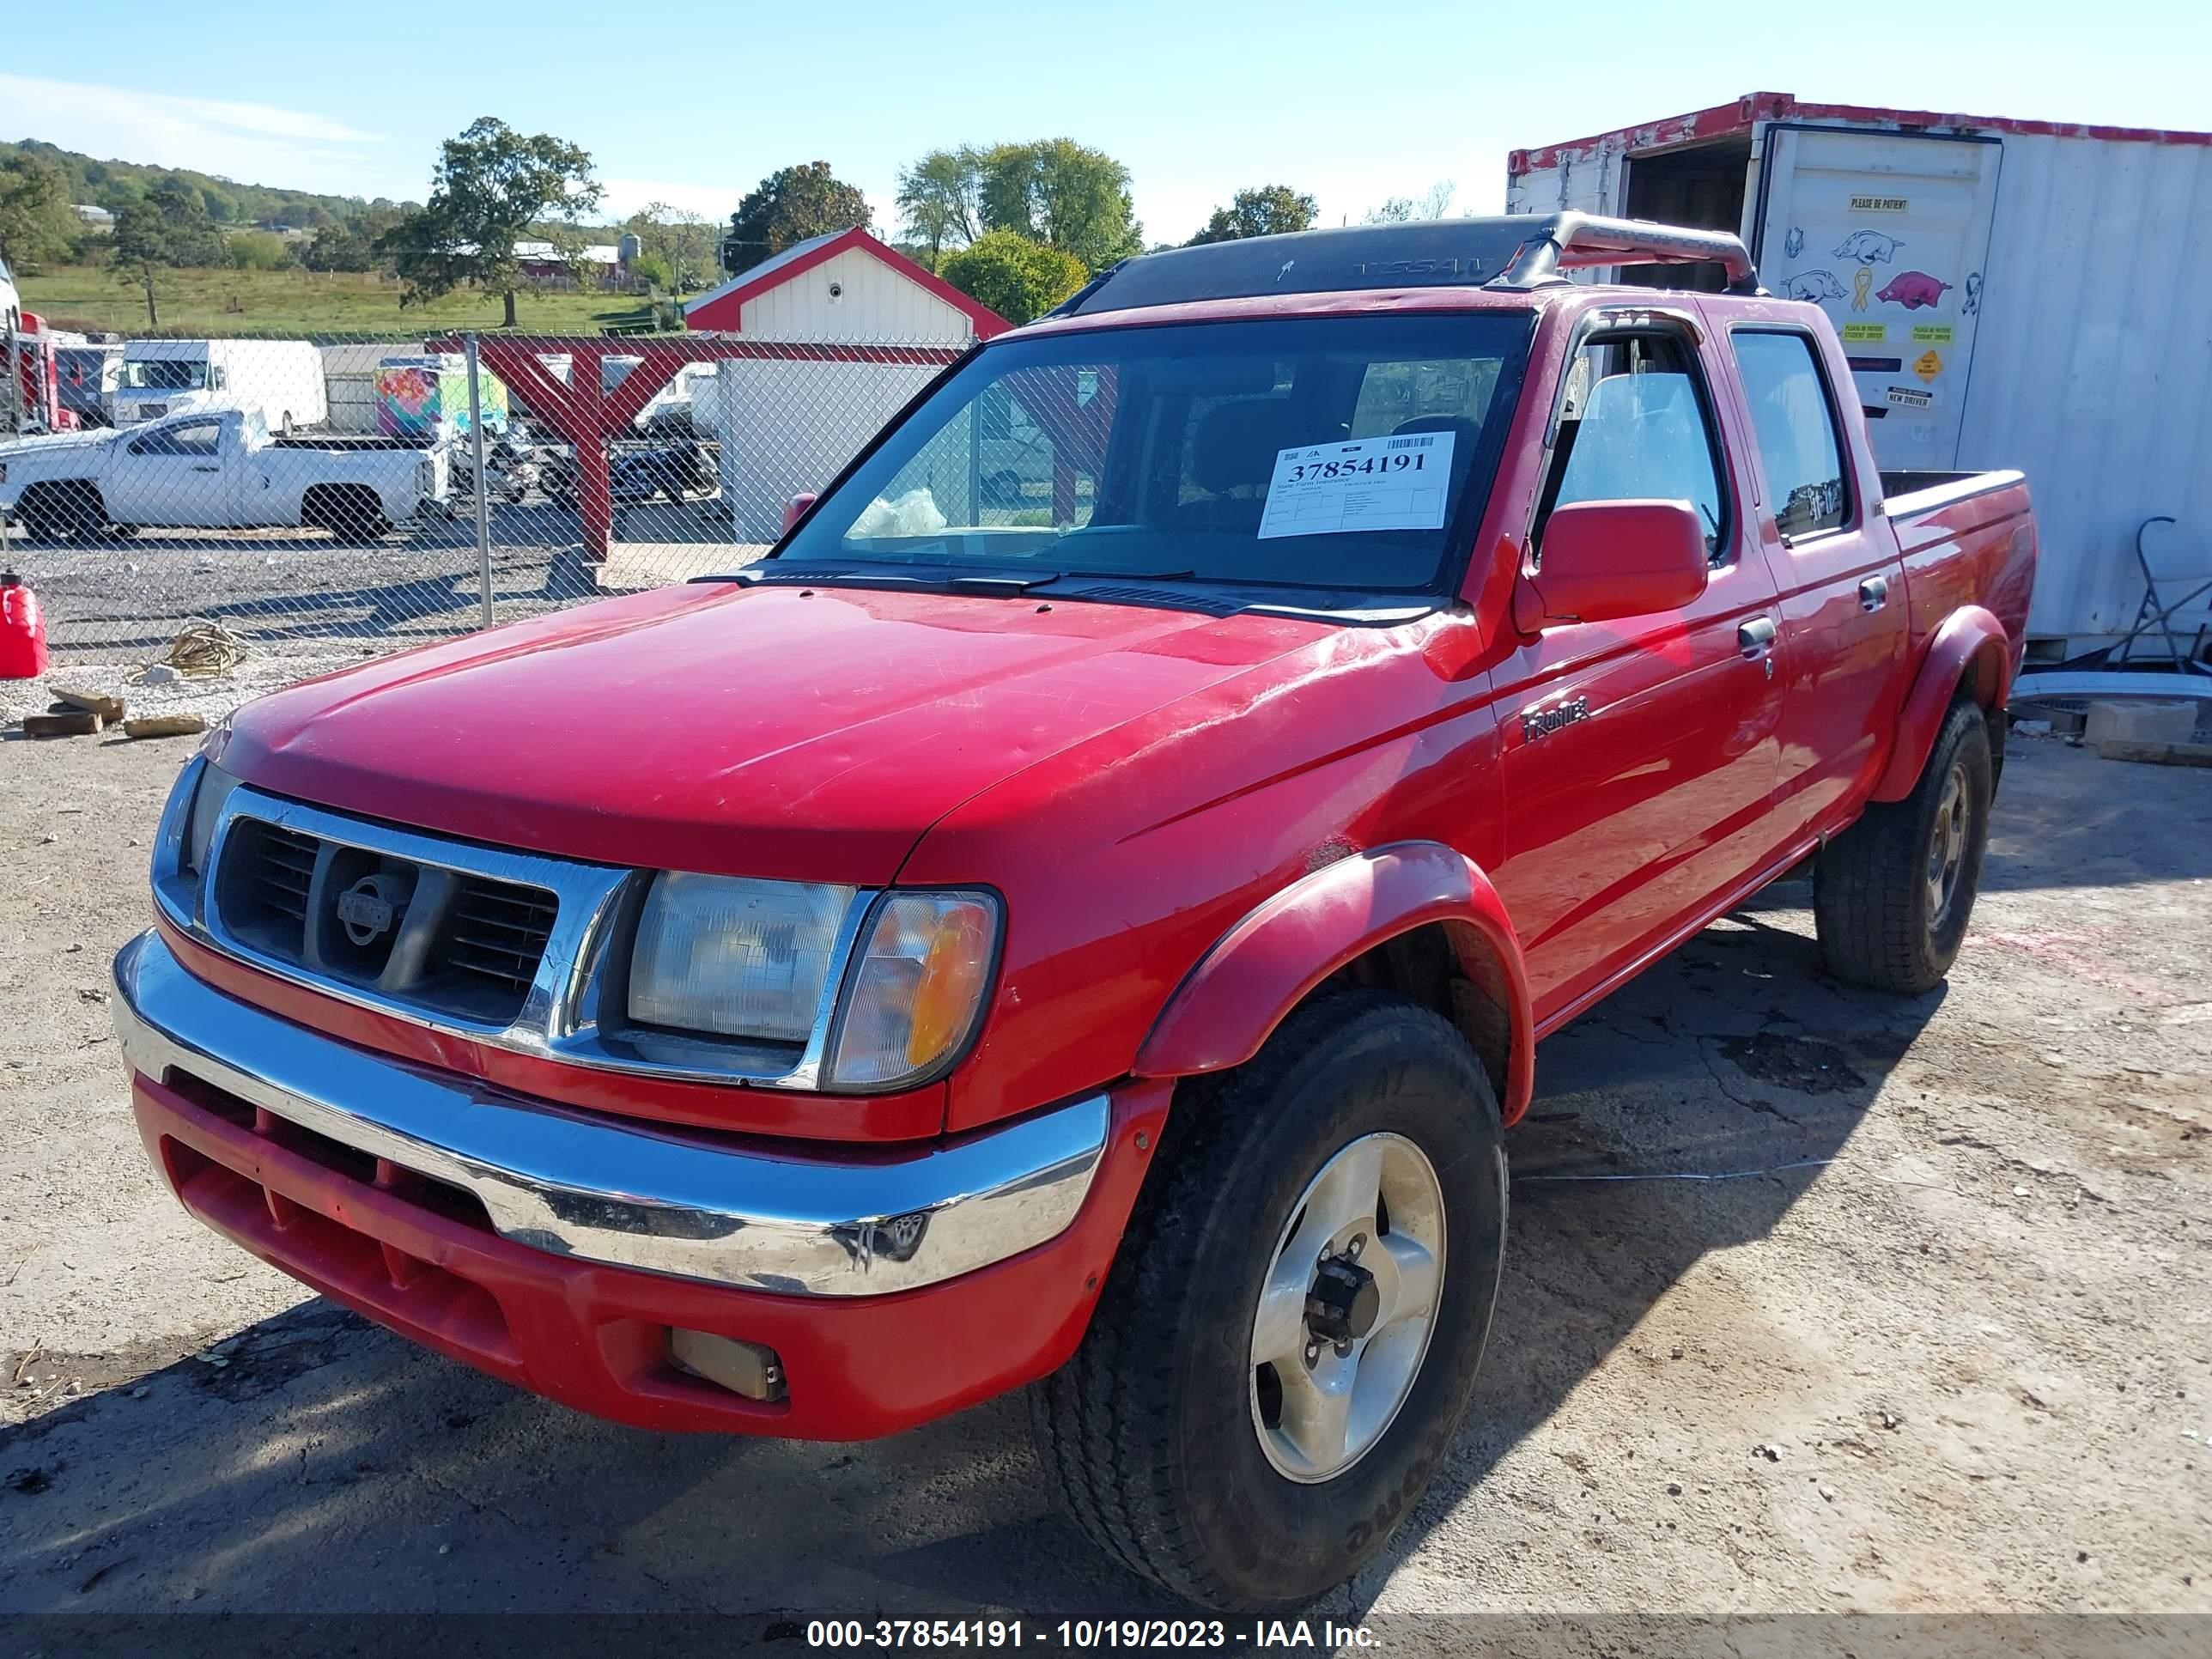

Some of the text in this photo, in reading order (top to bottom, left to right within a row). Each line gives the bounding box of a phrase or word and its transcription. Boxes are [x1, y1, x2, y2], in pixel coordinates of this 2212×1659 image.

[1851, 198, 1907, 210] PLEASE BE PATIENT
[1888, 393, 1929, 407] NEW DRIVER
[1287, 453, 1427, 483] 37854191
